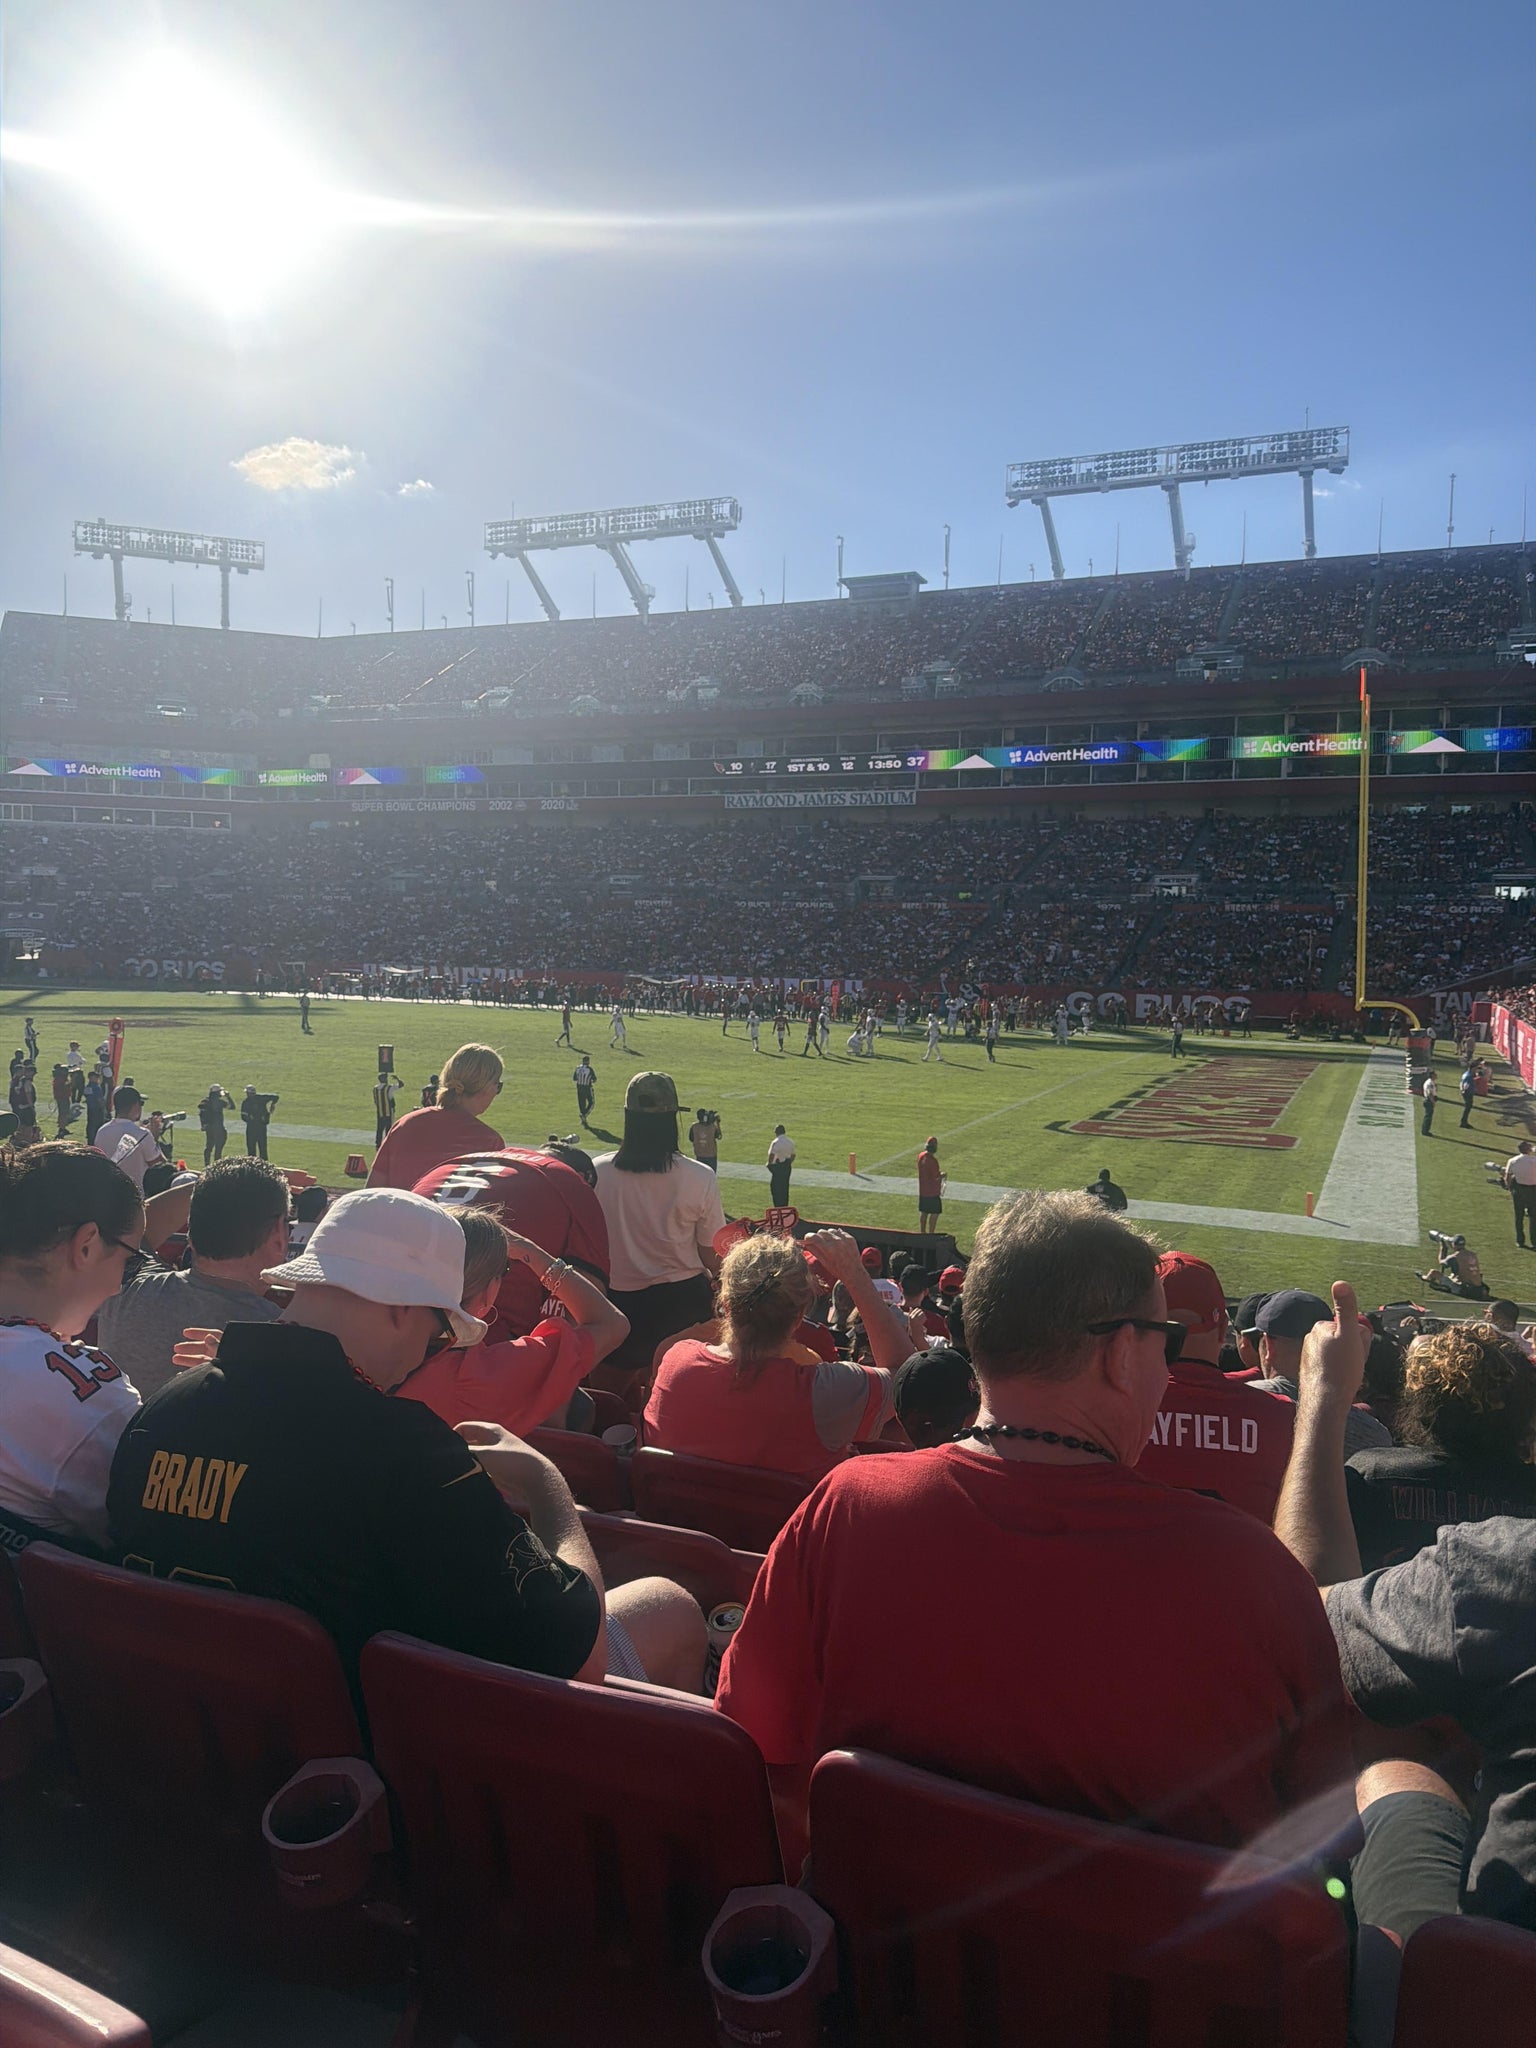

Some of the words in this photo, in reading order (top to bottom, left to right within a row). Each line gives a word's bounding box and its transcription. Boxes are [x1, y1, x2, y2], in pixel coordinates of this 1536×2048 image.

[1259, 735, 1368, 755] AdventHealth
[1023, 745, 1119, 764] AdventHealth
[730, 762, 742, 771] 10
[765, 761, 776, 770] 17
[787, 763, 805, 772] 1ST
[806, 763, 815, 772] &
[817, 763, 830, 771] 10
[842, 762, 854, 770] 12
[868, 760, 901, 769] 13:50
[907, 757, 925, 766] 37
[79, 763, 161, 778] AdventHealth
[267, 772, 328, 784] AdventHealth
[726, 794, 797, 808] RAYMOND
[798, 792, 846, 807] JAMES
[849, 791, 914, 806] STADIUM
[351, 801, 384, 812] SUPER
[386, 801, 416, 812] BOWL
[417, 801, 476, 812] CHAMPIONS
[489, 800, 513, 811] 2002
[541, 800, 564, 810] 2020
[45, 1344, 122, 1402] 13
[141, 1450, 249, 1524] BRADY
